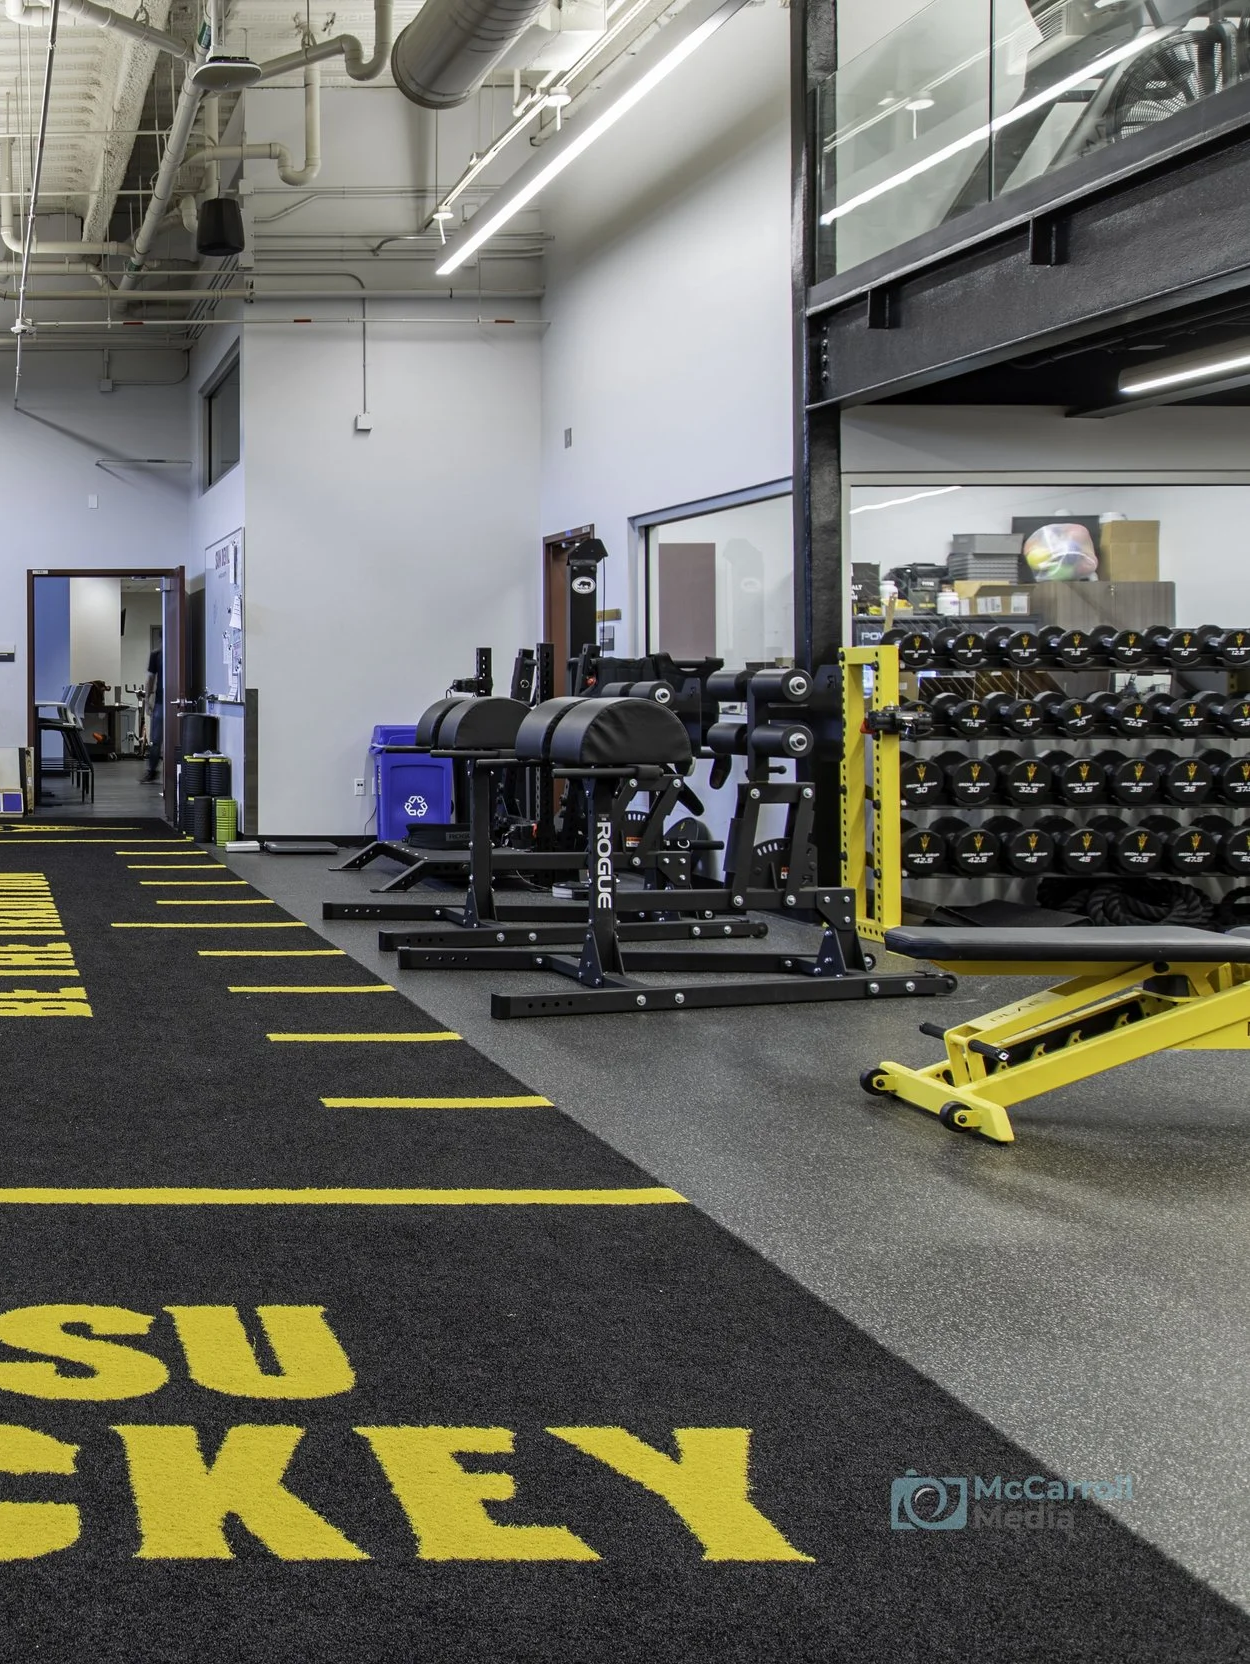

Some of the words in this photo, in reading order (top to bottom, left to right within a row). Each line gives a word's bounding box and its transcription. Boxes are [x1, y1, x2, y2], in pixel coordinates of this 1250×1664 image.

[1073, 786, 1093, 794] 32.5
[1183, 785, 1197, 793] 35
[967, 856, 988, 864] 42.5
[597, 821, 611, 908] ROGUE
